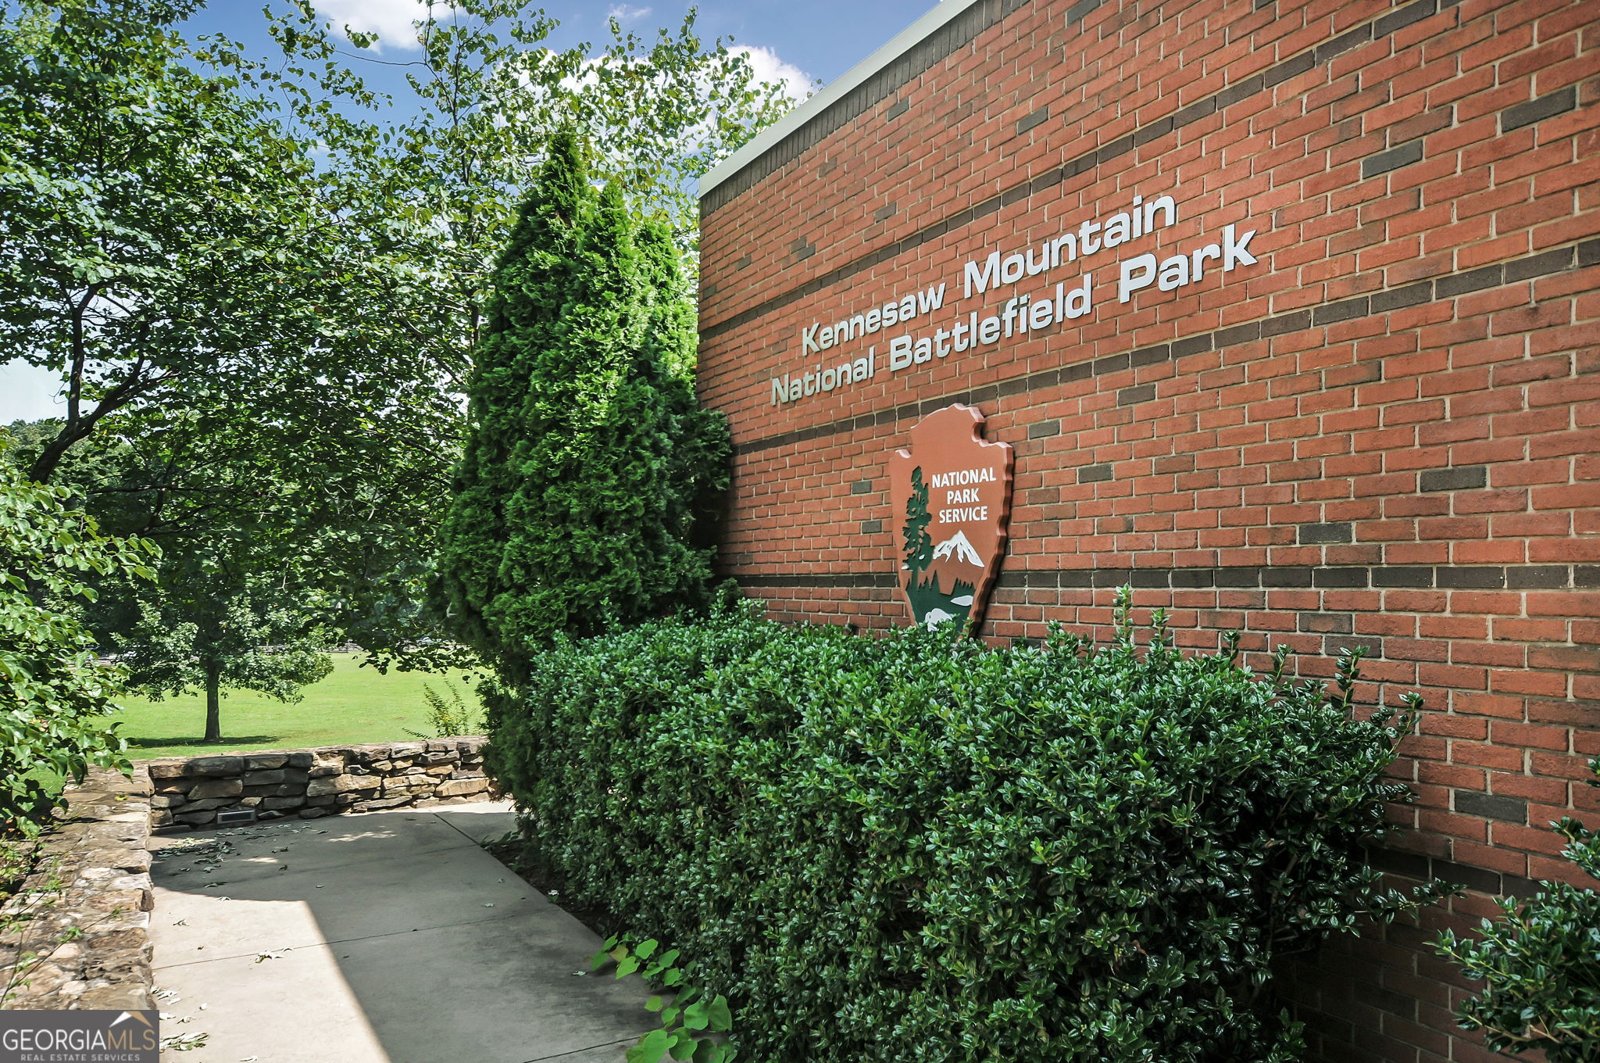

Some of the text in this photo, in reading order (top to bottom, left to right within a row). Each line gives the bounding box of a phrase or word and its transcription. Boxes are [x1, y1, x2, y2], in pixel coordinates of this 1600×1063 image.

[801, 194, 1177, 357] Kennesaw Mountain
[770, 223, 1258, 405] National Battlefield Park
[931, 467, 997, 488] NATIONAL
[946, 488, 980, 505] PARK
[938, 506, 988, 524] SERVICE
